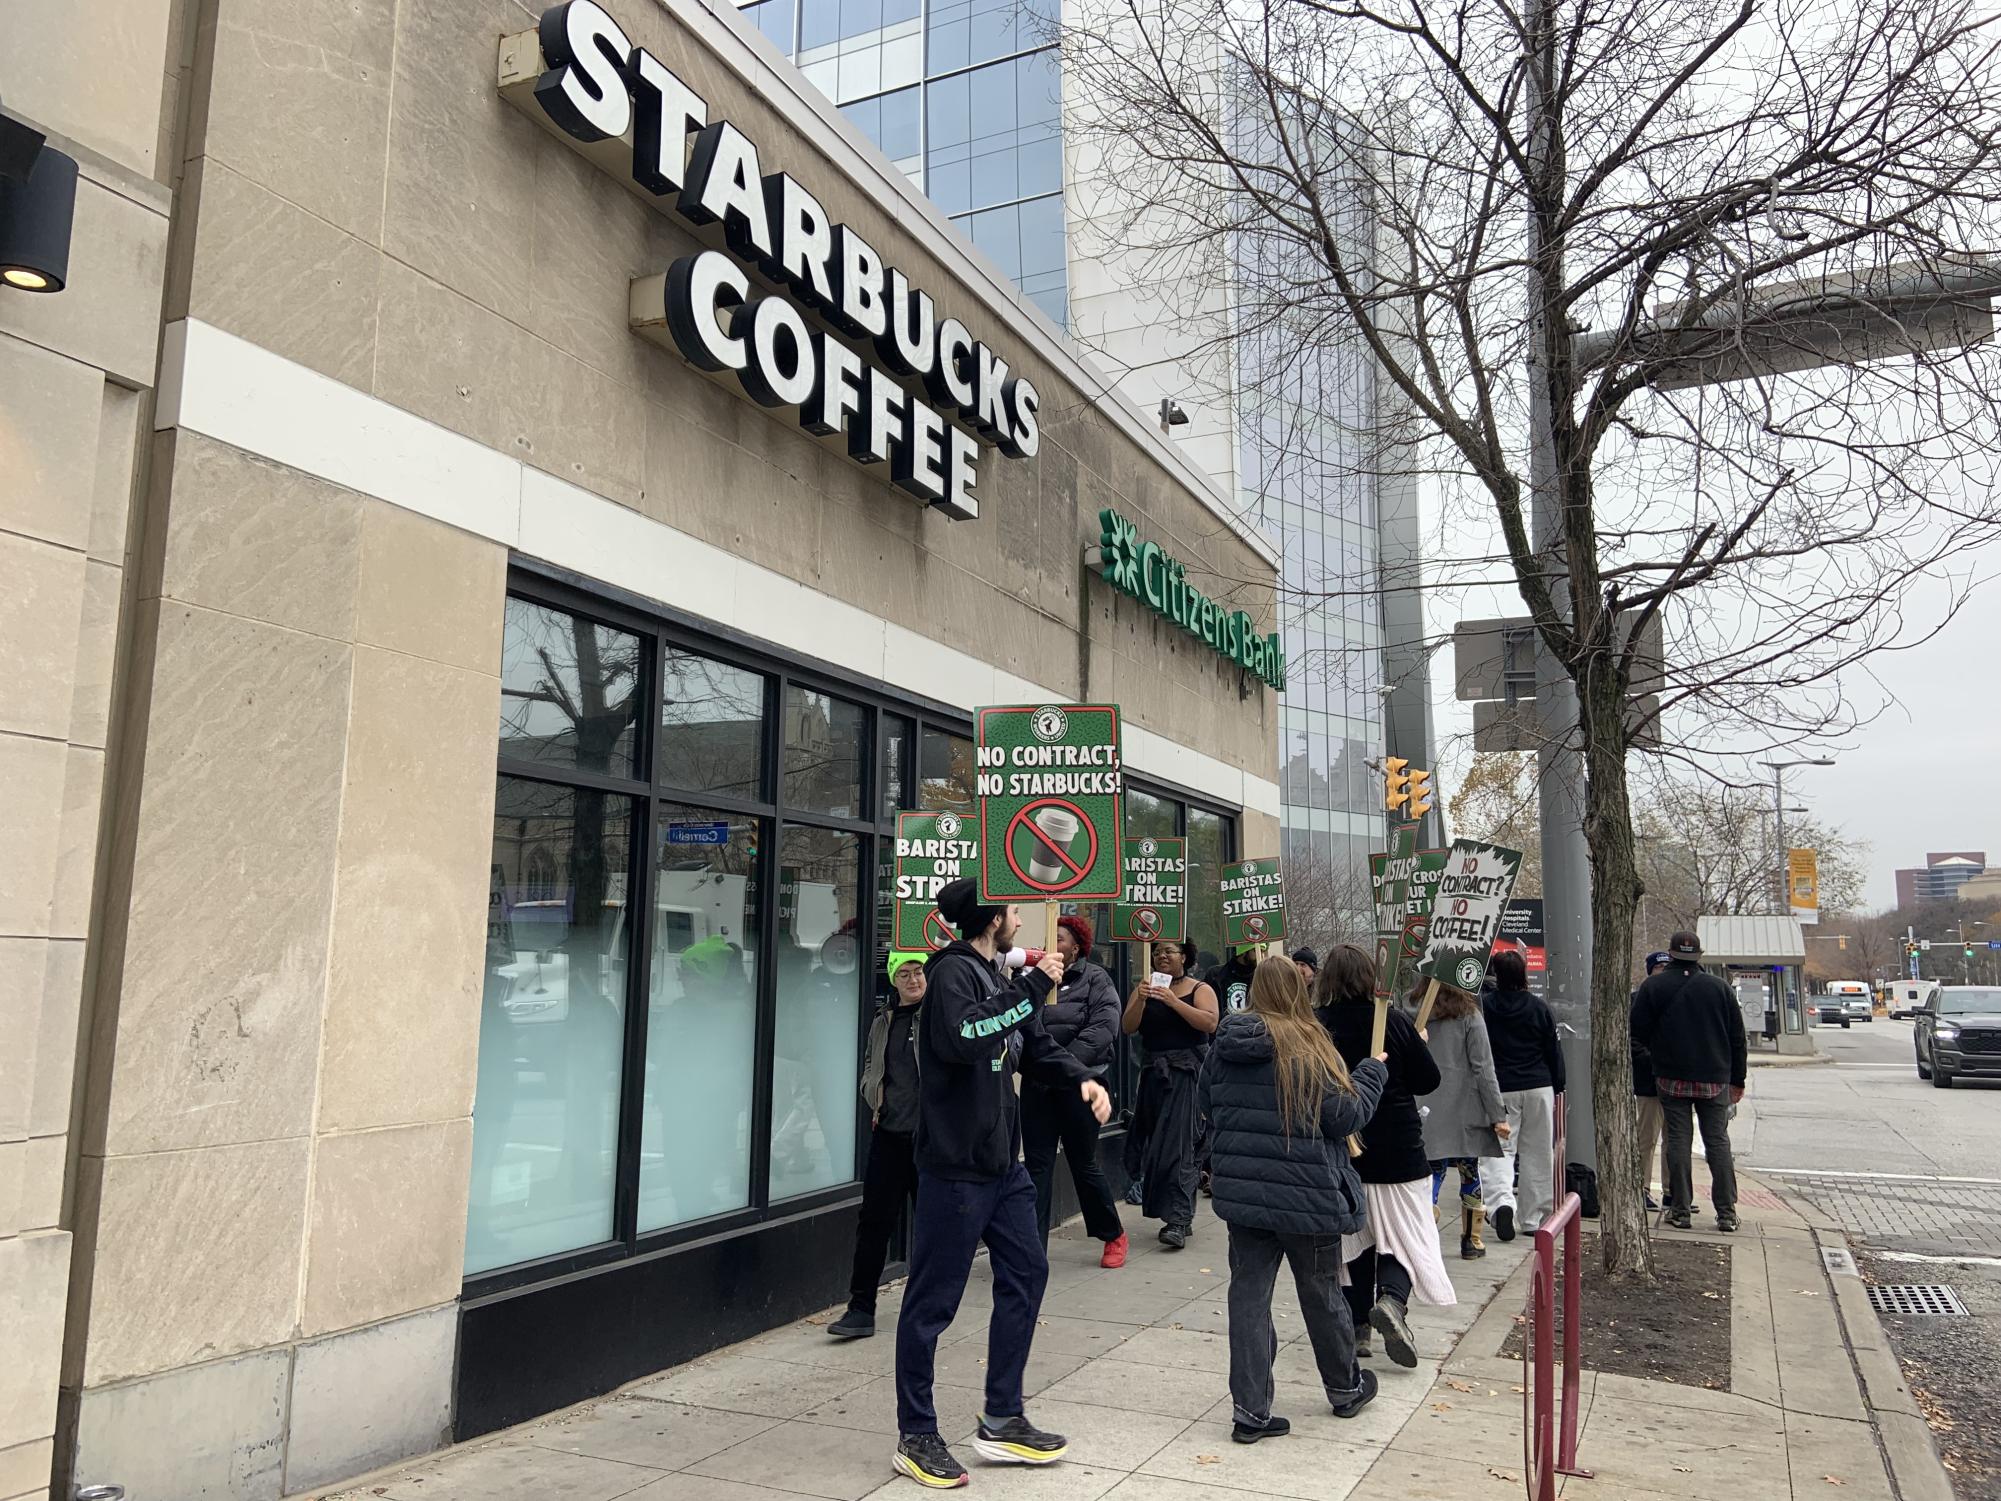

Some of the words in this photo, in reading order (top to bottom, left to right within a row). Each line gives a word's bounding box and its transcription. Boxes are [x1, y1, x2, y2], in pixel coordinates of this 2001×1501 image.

[555, 0, 1040, 458] STARBUCKS
[683, 250, 979, 520] COFFEE
[1143, 541, 1238, 660] Citizens
[1239, 611, 1287, 692] Bank
[977, 746, 1005, 767] NO
[1012, 745, 1120, 768] CONTRACT,
[977, 774, 1003, 795] NO
[1009, 772, 1121, 795] STARBUCKS!
[934, 860, 960, 876] ON
[1461, 858, 1478, 874] NO
[896, 875, 961, 899] STR
[1137, 872, 1157, 884] ON
[1220, 873, 1281, 891] BARISTAS
[1441, 875, 1505, 897] CONTRACT?
[1243, 887, 1260, 897] ON
[1384, 883, 1394, 903] ON
[1223, 894, 1284, 914] STRIKE!
[1450, 899, 1468, 916] NO
